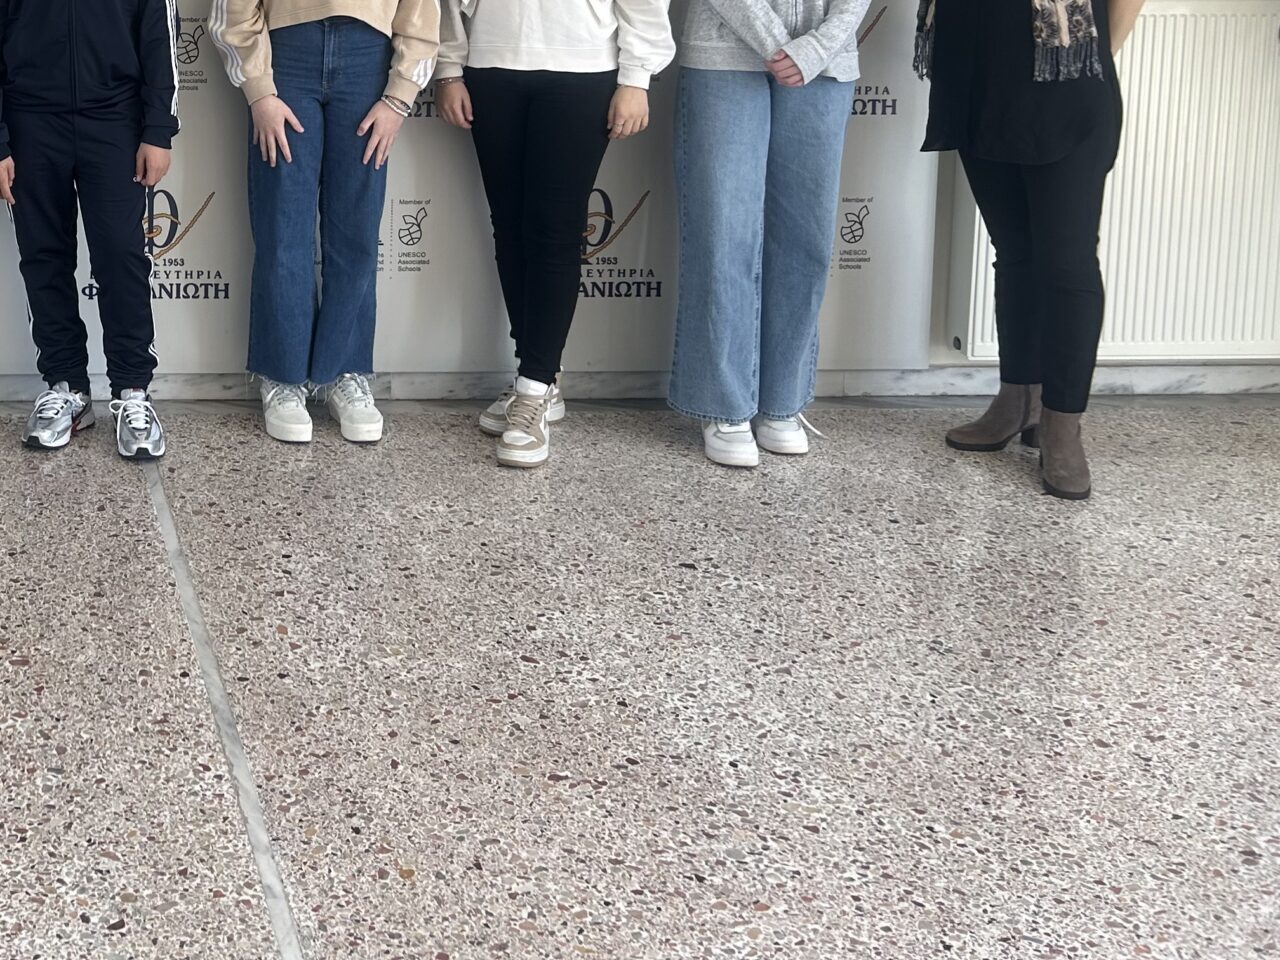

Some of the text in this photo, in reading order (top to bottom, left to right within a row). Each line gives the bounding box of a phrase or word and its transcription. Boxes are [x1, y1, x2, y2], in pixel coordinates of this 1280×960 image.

[162, 258, 185, 266] 1953
[596, 257, 618, 265] 1953
[586, 268, 655, 278] ΕΥΤΗΡΙΑ
[578, 281, 662, 298] ΑΝΙΩΤΗ
